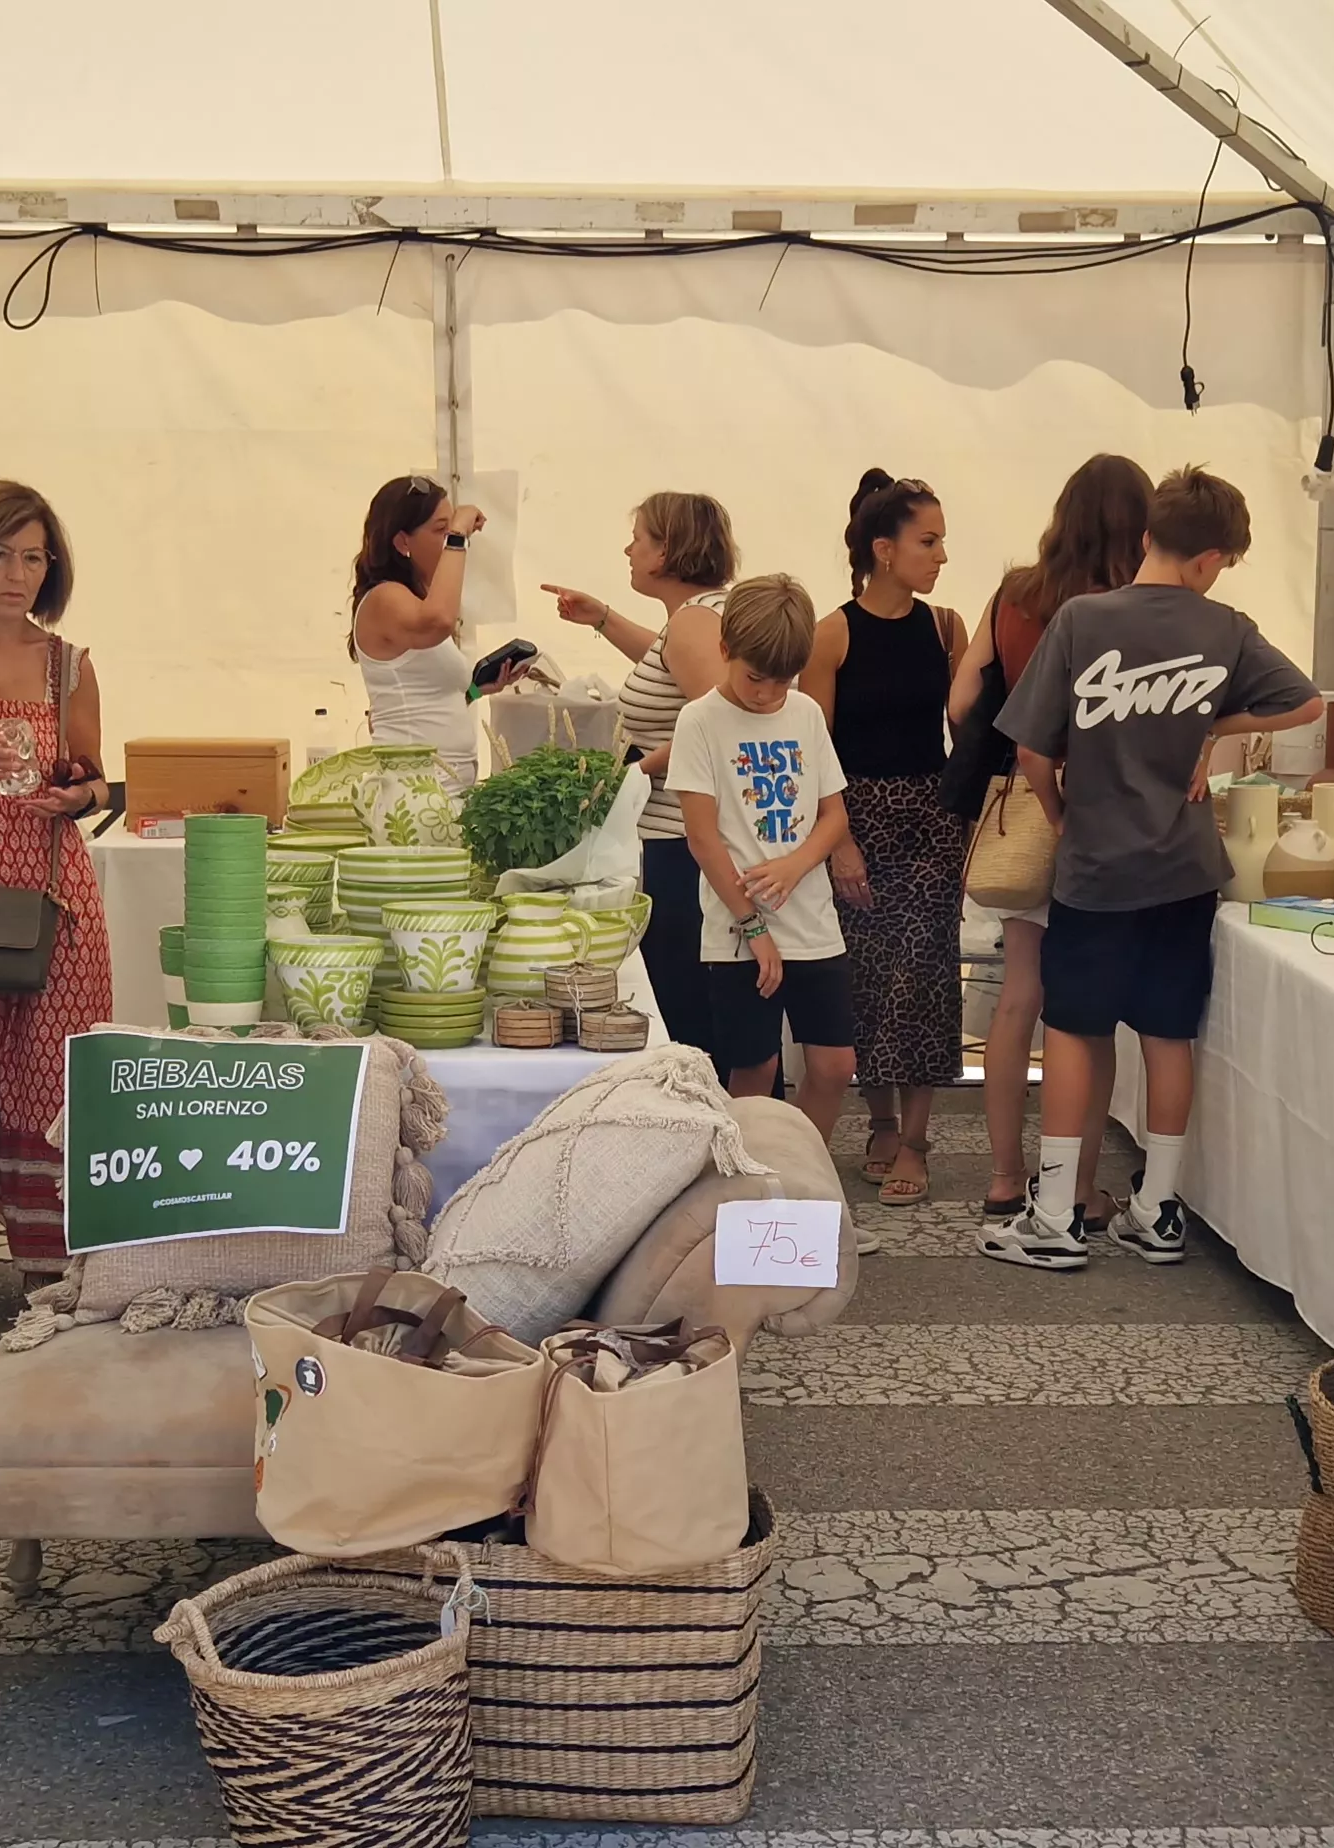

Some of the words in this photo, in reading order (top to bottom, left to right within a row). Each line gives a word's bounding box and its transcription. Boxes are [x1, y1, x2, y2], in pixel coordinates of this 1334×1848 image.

[737, 740, 800, 776] JUST
[753, 775, 797, 809] DO
[110, 1058, 305, 1094] REBAJAS
[136, 1102, 173, 1120] SAN
[178, 1100, 268, 1117] LORENZO
[89, 1146, 162, 1187] 50%
[226, 1140, 320, 1173] 40%
